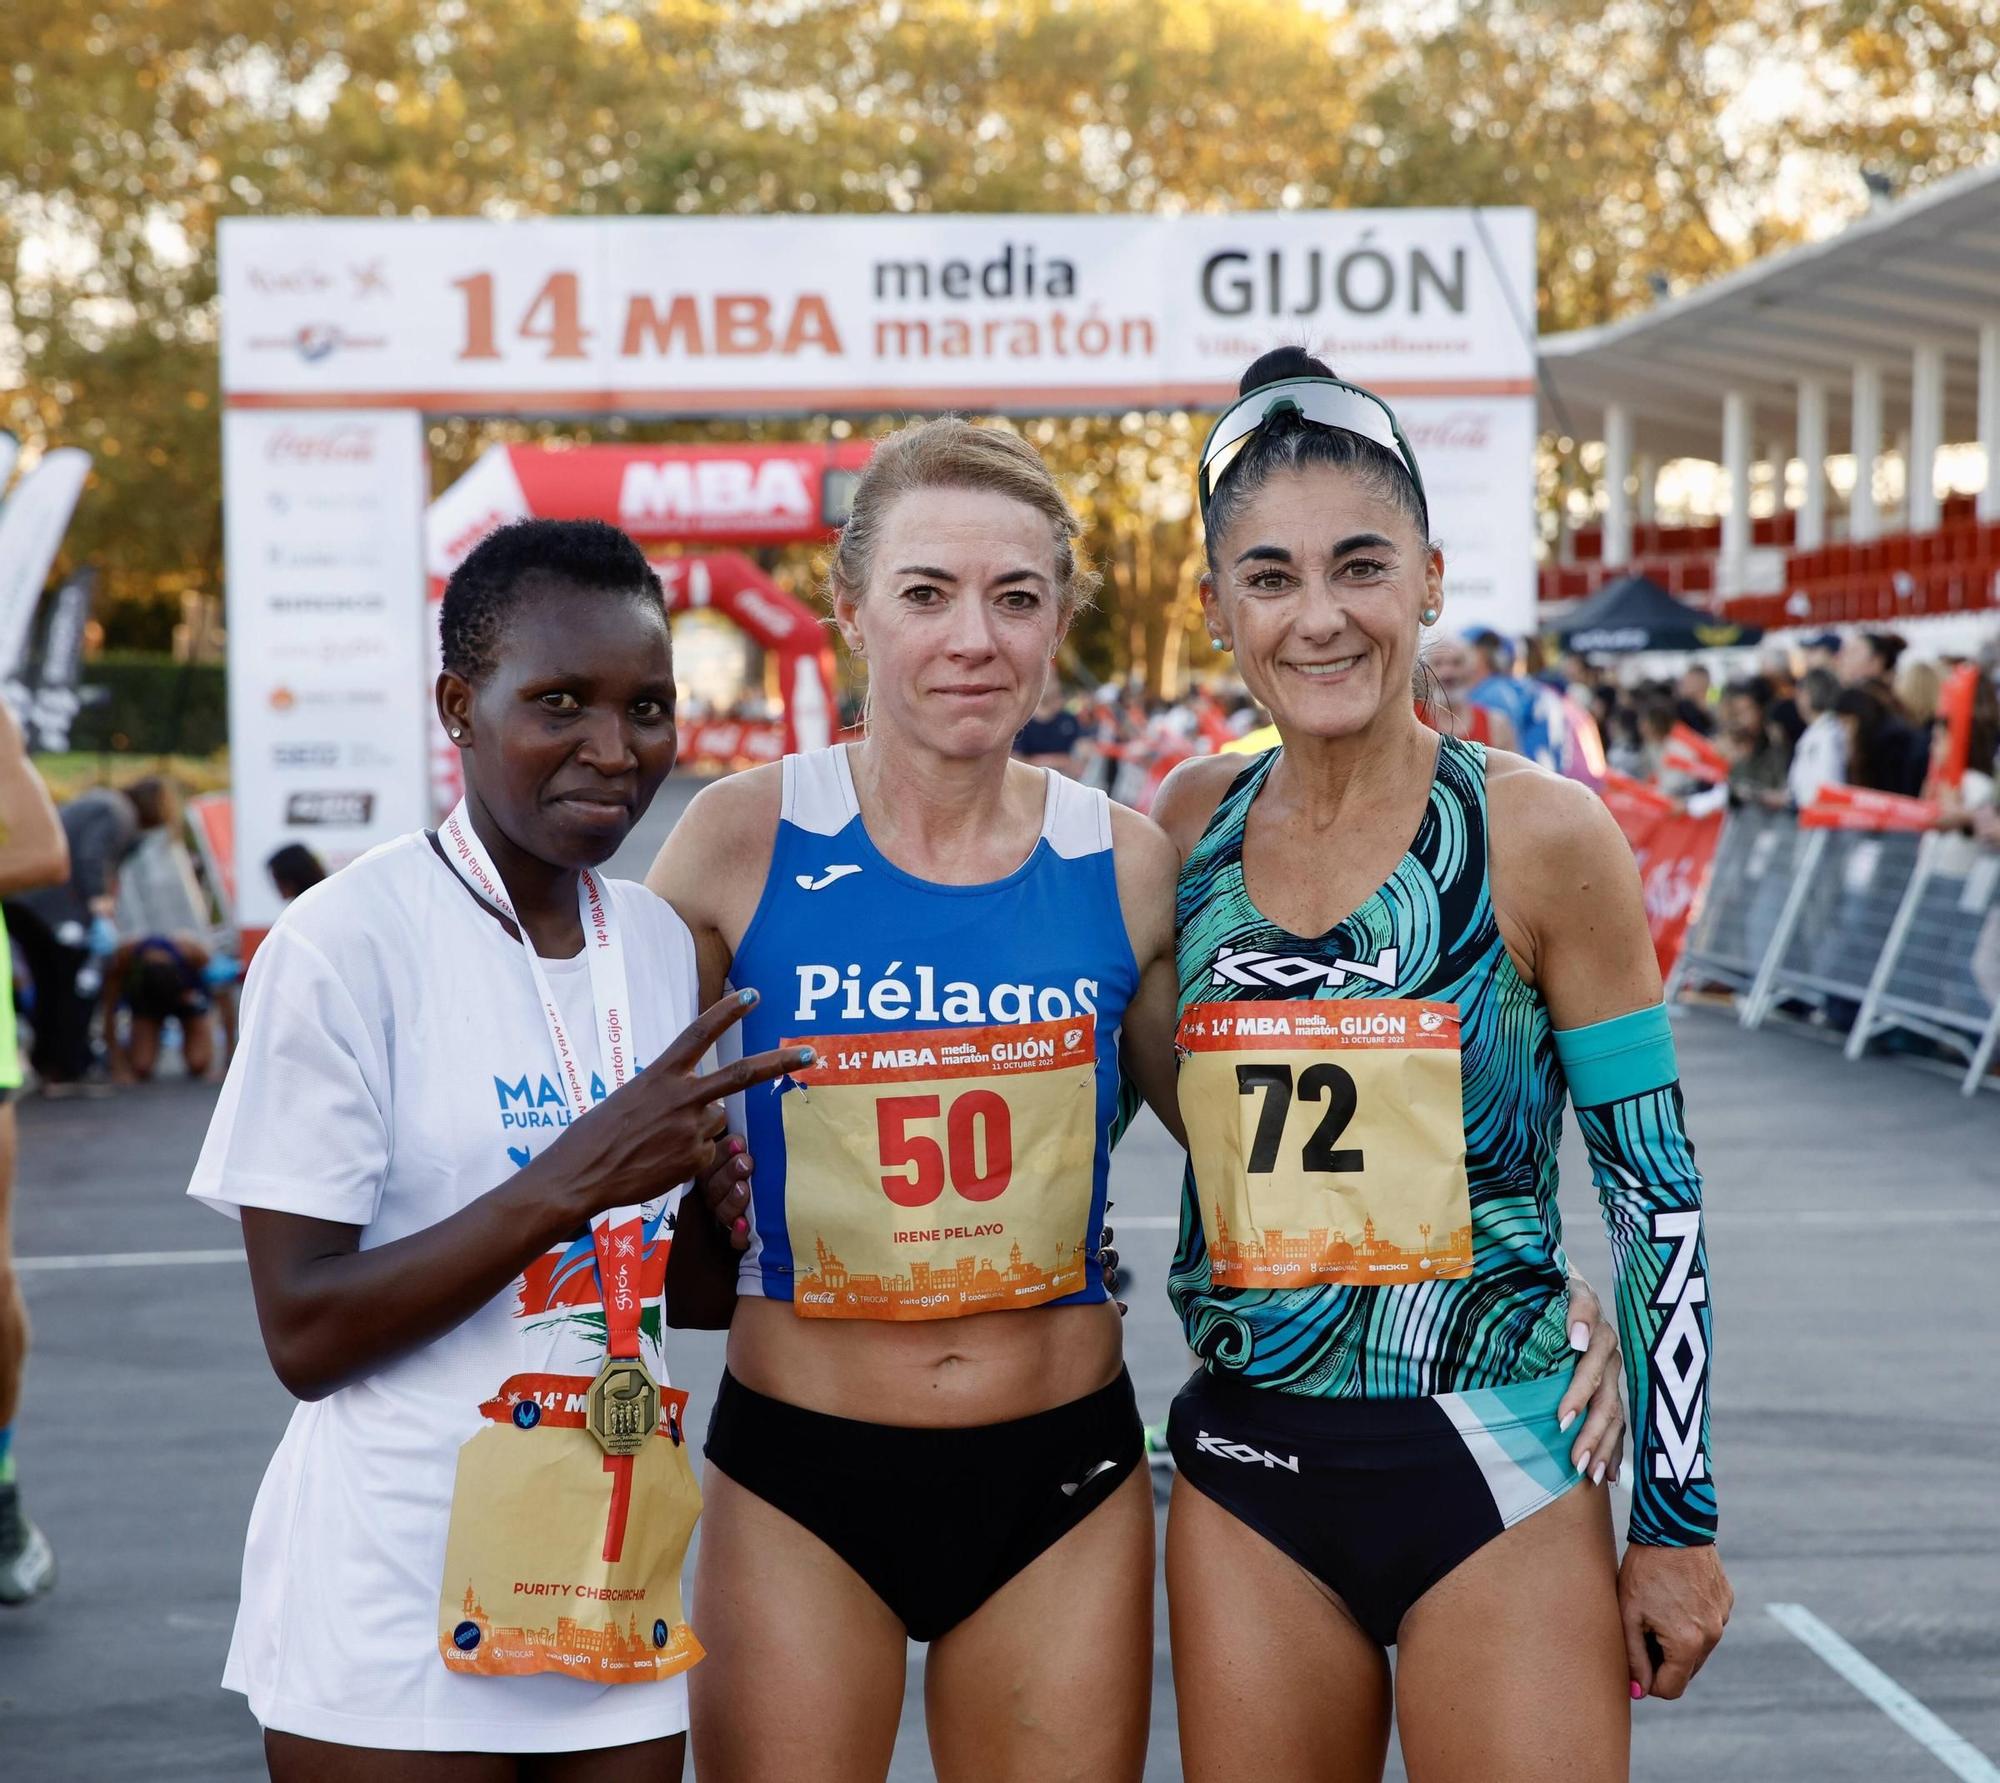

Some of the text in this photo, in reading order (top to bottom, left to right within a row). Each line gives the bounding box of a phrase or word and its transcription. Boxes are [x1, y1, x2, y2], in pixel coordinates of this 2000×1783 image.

[875, 244, 1077, 301] media
[1201, 227, 1467, 318] GIJÓN
[454, 269, 844, 361] 14 MBA
[875, 306, 1156, 359] maratón
[619, 458, 812, 518] MBA
[591, 902, 606, 928] MBA
[794, 960, 1098, 1031] Piélagos
[1211, 1017, 1291, 1036] 14ª MBA
[1295, 1014, 1326, 1026] media
[1295, 1024, 1338, 1036] maratón
[1340, 1012, 1406, 1036] GIJÓN
[607, 1008, 626, 1088] aratón Gijón
[941, 1043, 977, 1056] media
[991, 1036, 1054, 1062] GIJÓN
[1351, 1036, 1386, 1044] OCTUBRE
[1388, 1036, 1405, 1044] 2025
[838, 1048, 937, 1070] 14ª MBA
[941, 1052, 990, 1065] maratón
[1003, 1061, 1037, 1070] OCTUBRE
[1039, 1058, 1054, 1066] 2025
[502, 1111, 553, 1129] PURA
[1235, 1063, 1365, 1173] 72
[875, 1089, 1013, 1208] 50
[893, 1223, 1004, 1244] IRENE PELAYO
[1272, 1262, 1301, 1275] gijón
[1368, 1263, 1409, 1272] SIROKO
[615, 1263, 634, 1311] gijón
[1014, 1283, 1047, 1296] SIROKO
[899, 1292, 950, 1308] visita gijón
[602, 1454, 634, 1563] 1
[513, 1582, 572, 1597] PURITY
[562, 1652, 592, 1666] gijón
